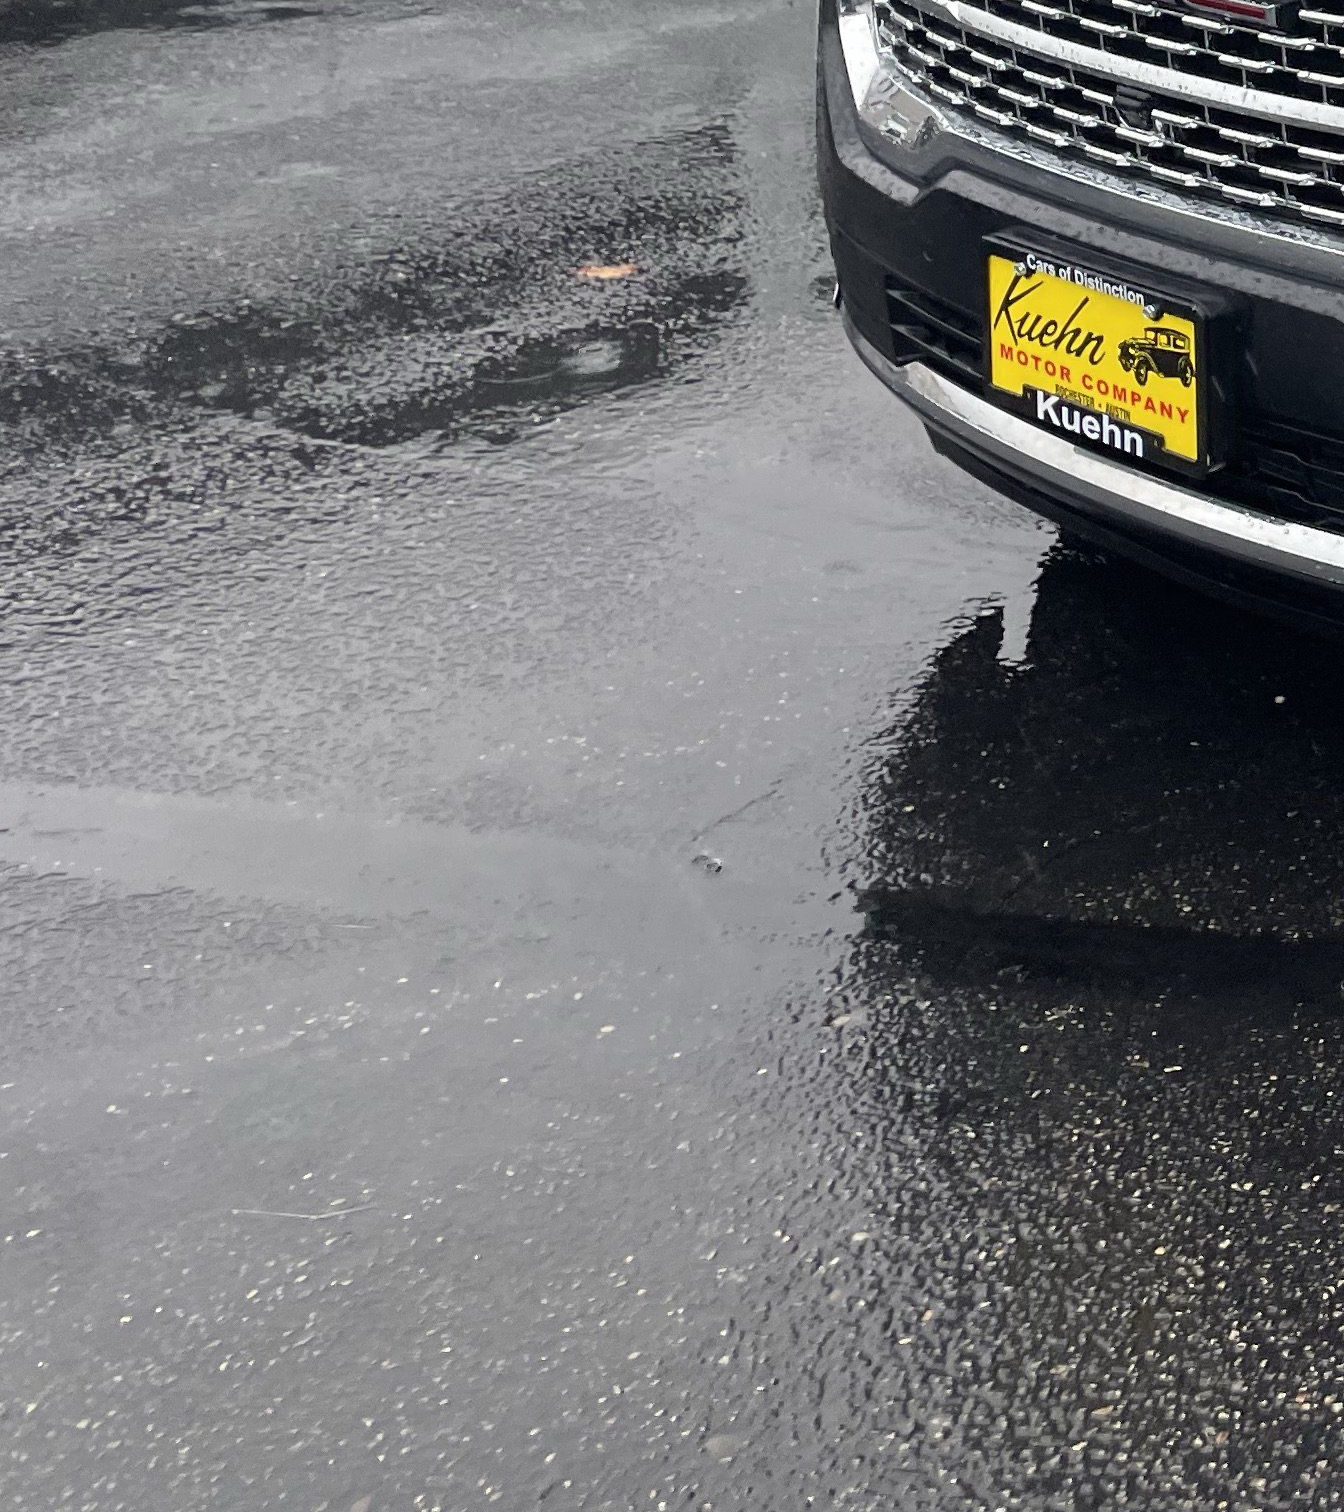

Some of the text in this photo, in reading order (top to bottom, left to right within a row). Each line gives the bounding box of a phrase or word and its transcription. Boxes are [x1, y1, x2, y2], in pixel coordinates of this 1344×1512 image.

[1026, 254, 1145, 307] Cars of Distinction
[993, 272, 1106, 366] Kuehn
[999, 342, 1190, 424] MOTOR COMPANY
[1036, 390, 1144, 458] Kuehn
